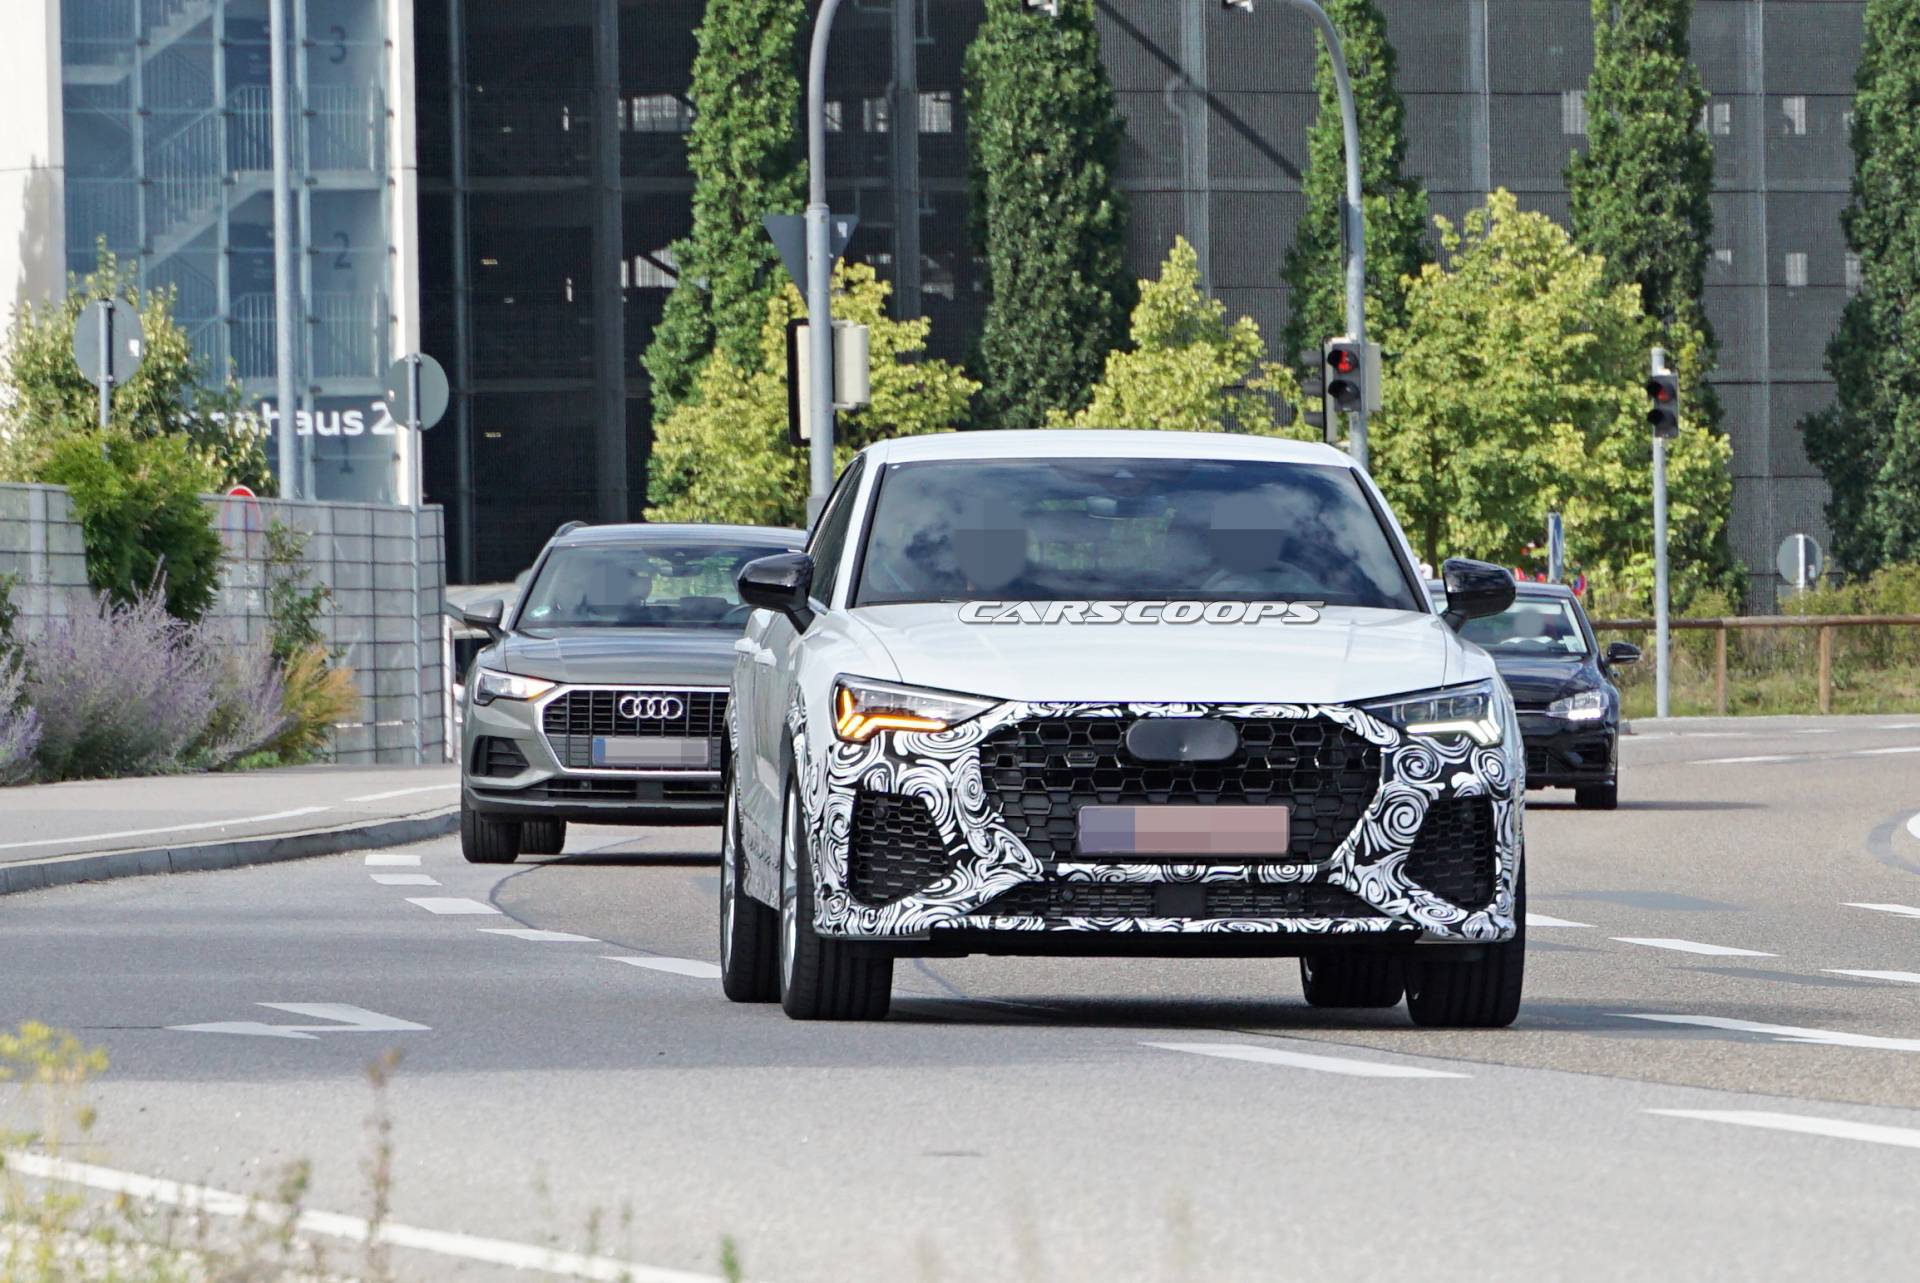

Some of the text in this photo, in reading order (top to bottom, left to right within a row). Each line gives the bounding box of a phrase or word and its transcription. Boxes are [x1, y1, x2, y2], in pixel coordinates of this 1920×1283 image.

[329, 25, 347, 64] 3
[334, 230, 352, 270] 2
[371, 402, 396, 435] 2
